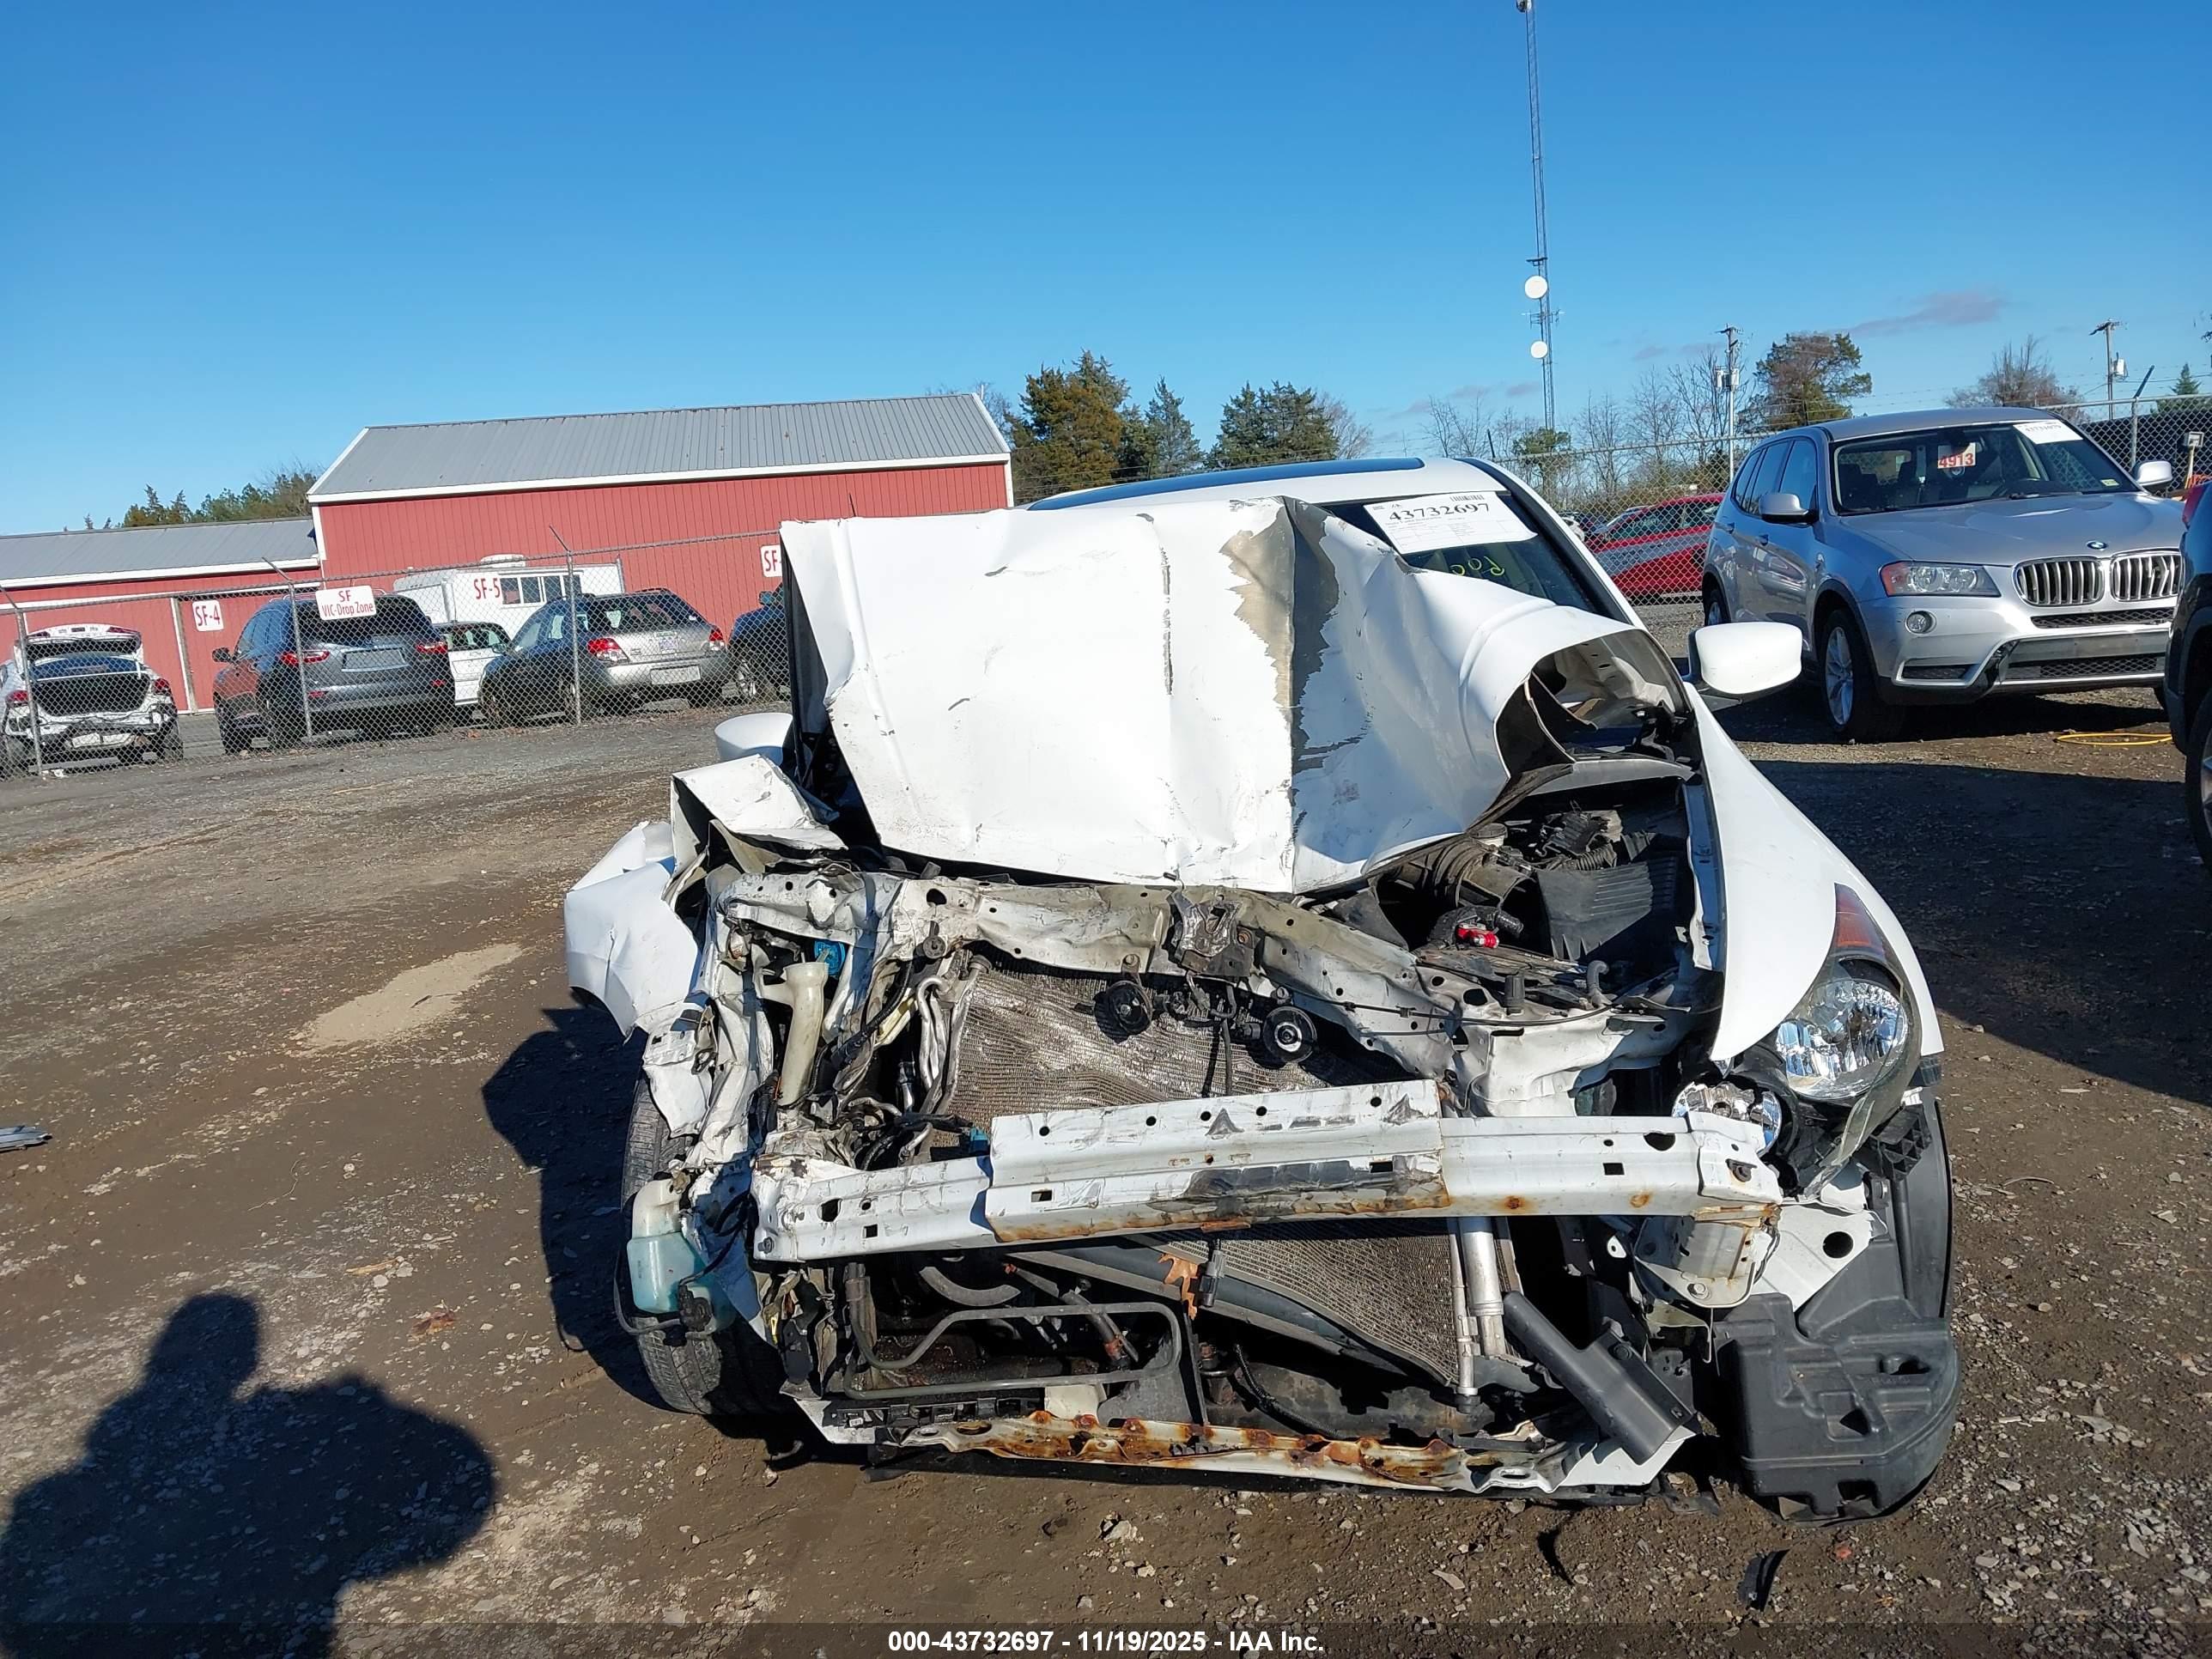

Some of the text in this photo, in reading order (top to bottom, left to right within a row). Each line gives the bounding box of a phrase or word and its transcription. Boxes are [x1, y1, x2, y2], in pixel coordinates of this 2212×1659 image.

[1938, 453, 1974, 468] 4913
[1389, 503, 1489, 520] 43732697
[763, 550, 781, 572] SF-
[338, 590, 351, 602] SF
[473, 577, 501, 599] SF-5
[195, 605, 221, 626] SF-4
[321, 602, 374, 617] VIC-Drop Zone
